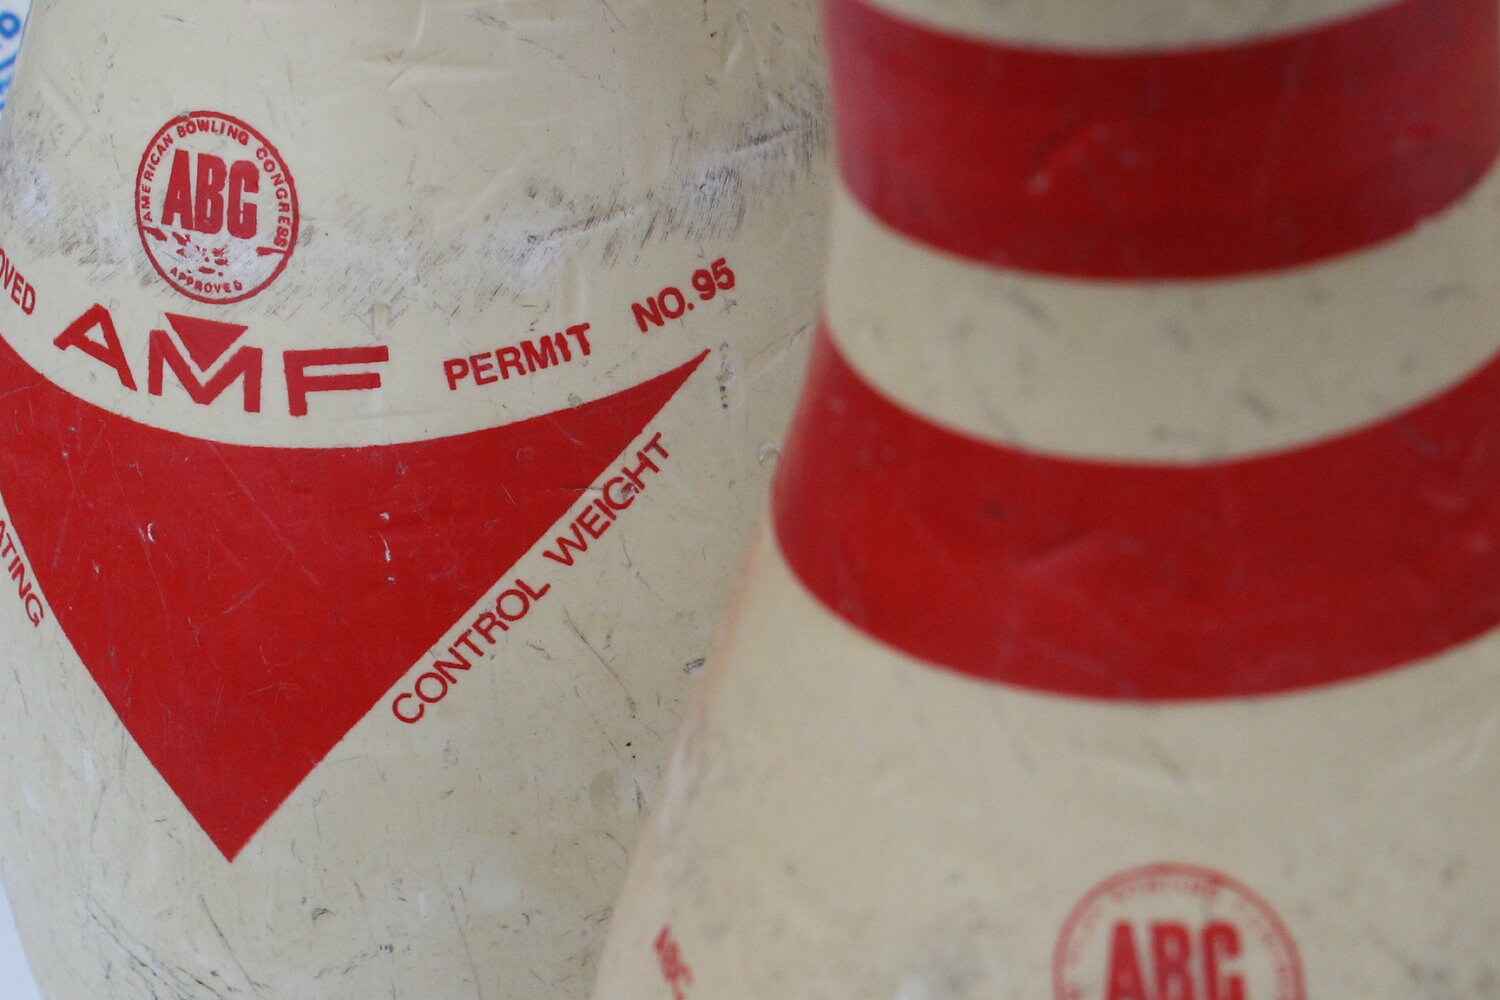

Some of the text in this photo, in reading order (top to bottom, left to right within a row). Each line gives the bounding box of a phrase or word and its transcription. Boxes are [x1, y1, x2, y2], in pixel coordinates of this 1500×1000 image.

[141, 118, 291, 248] AMERICAN BOWLING CONGRESS
[161, 149, 260, 240] ABC
[170, 266, 244, 294] APPROVED
[443, 257, 736, 390] PERMIT NO. 95
[53, 303, 388, 416] AMF
[391, 432, 670, 724] CONTROL WEIGHT
